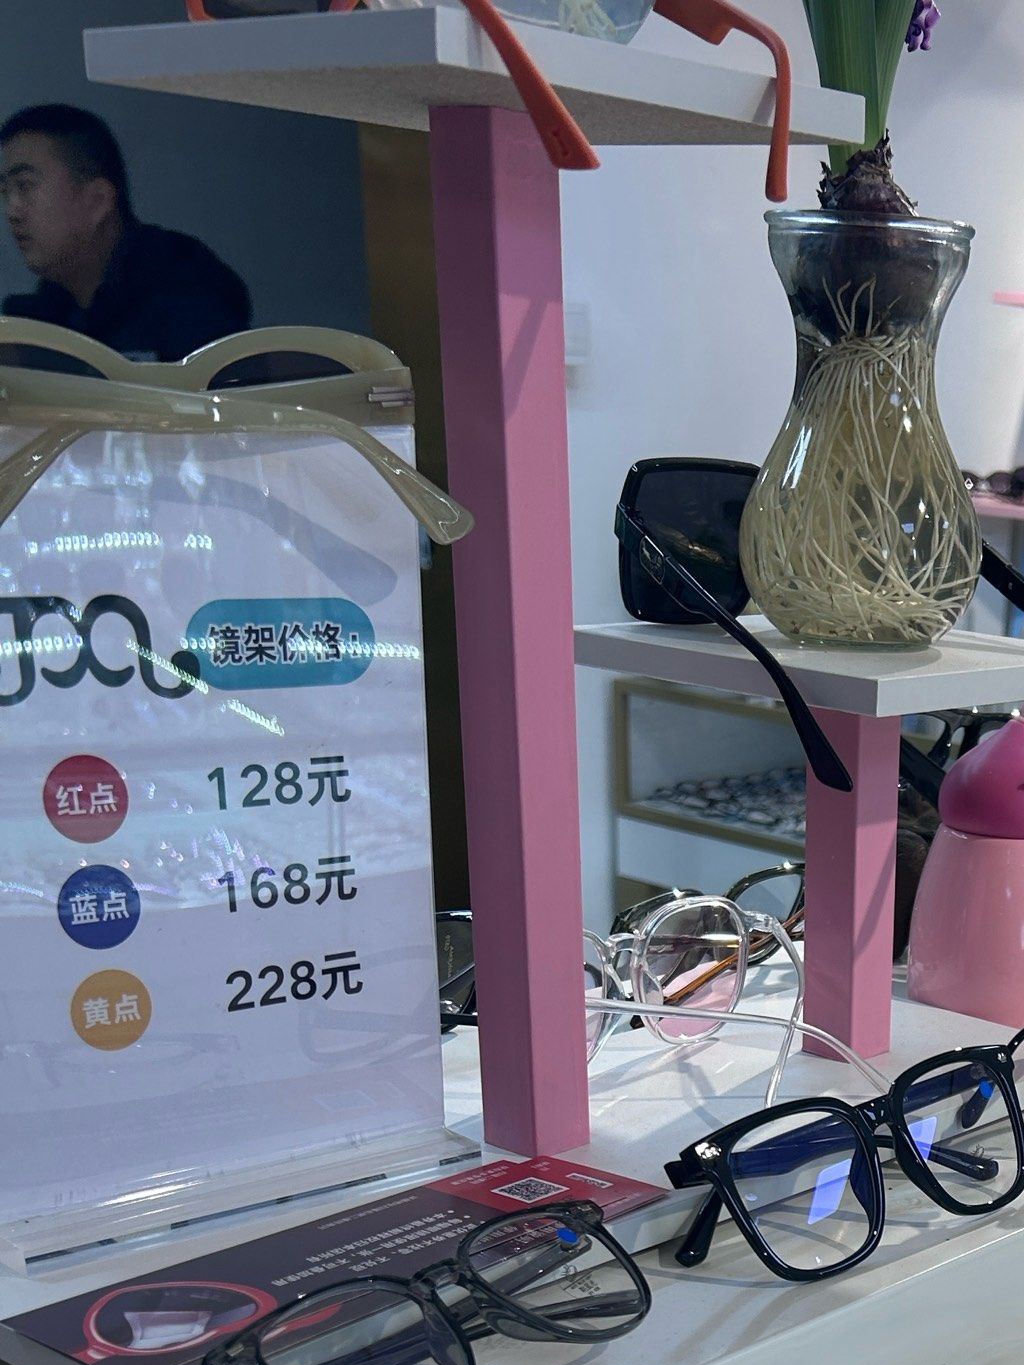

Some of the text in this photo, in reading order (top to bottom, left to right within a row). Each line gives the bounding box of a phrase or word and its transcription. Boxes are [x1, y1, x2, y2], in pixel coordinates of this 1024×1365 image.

[56, 781, 119, 817] 红点
[208, 757, 352, 812] 128元
[69, 889, 131, 926] 蓝点
[217, 855, 359, 915] 168元
[226, 952, 364, 1013] 228元
[82, 993, 143, 1029] 黄点
